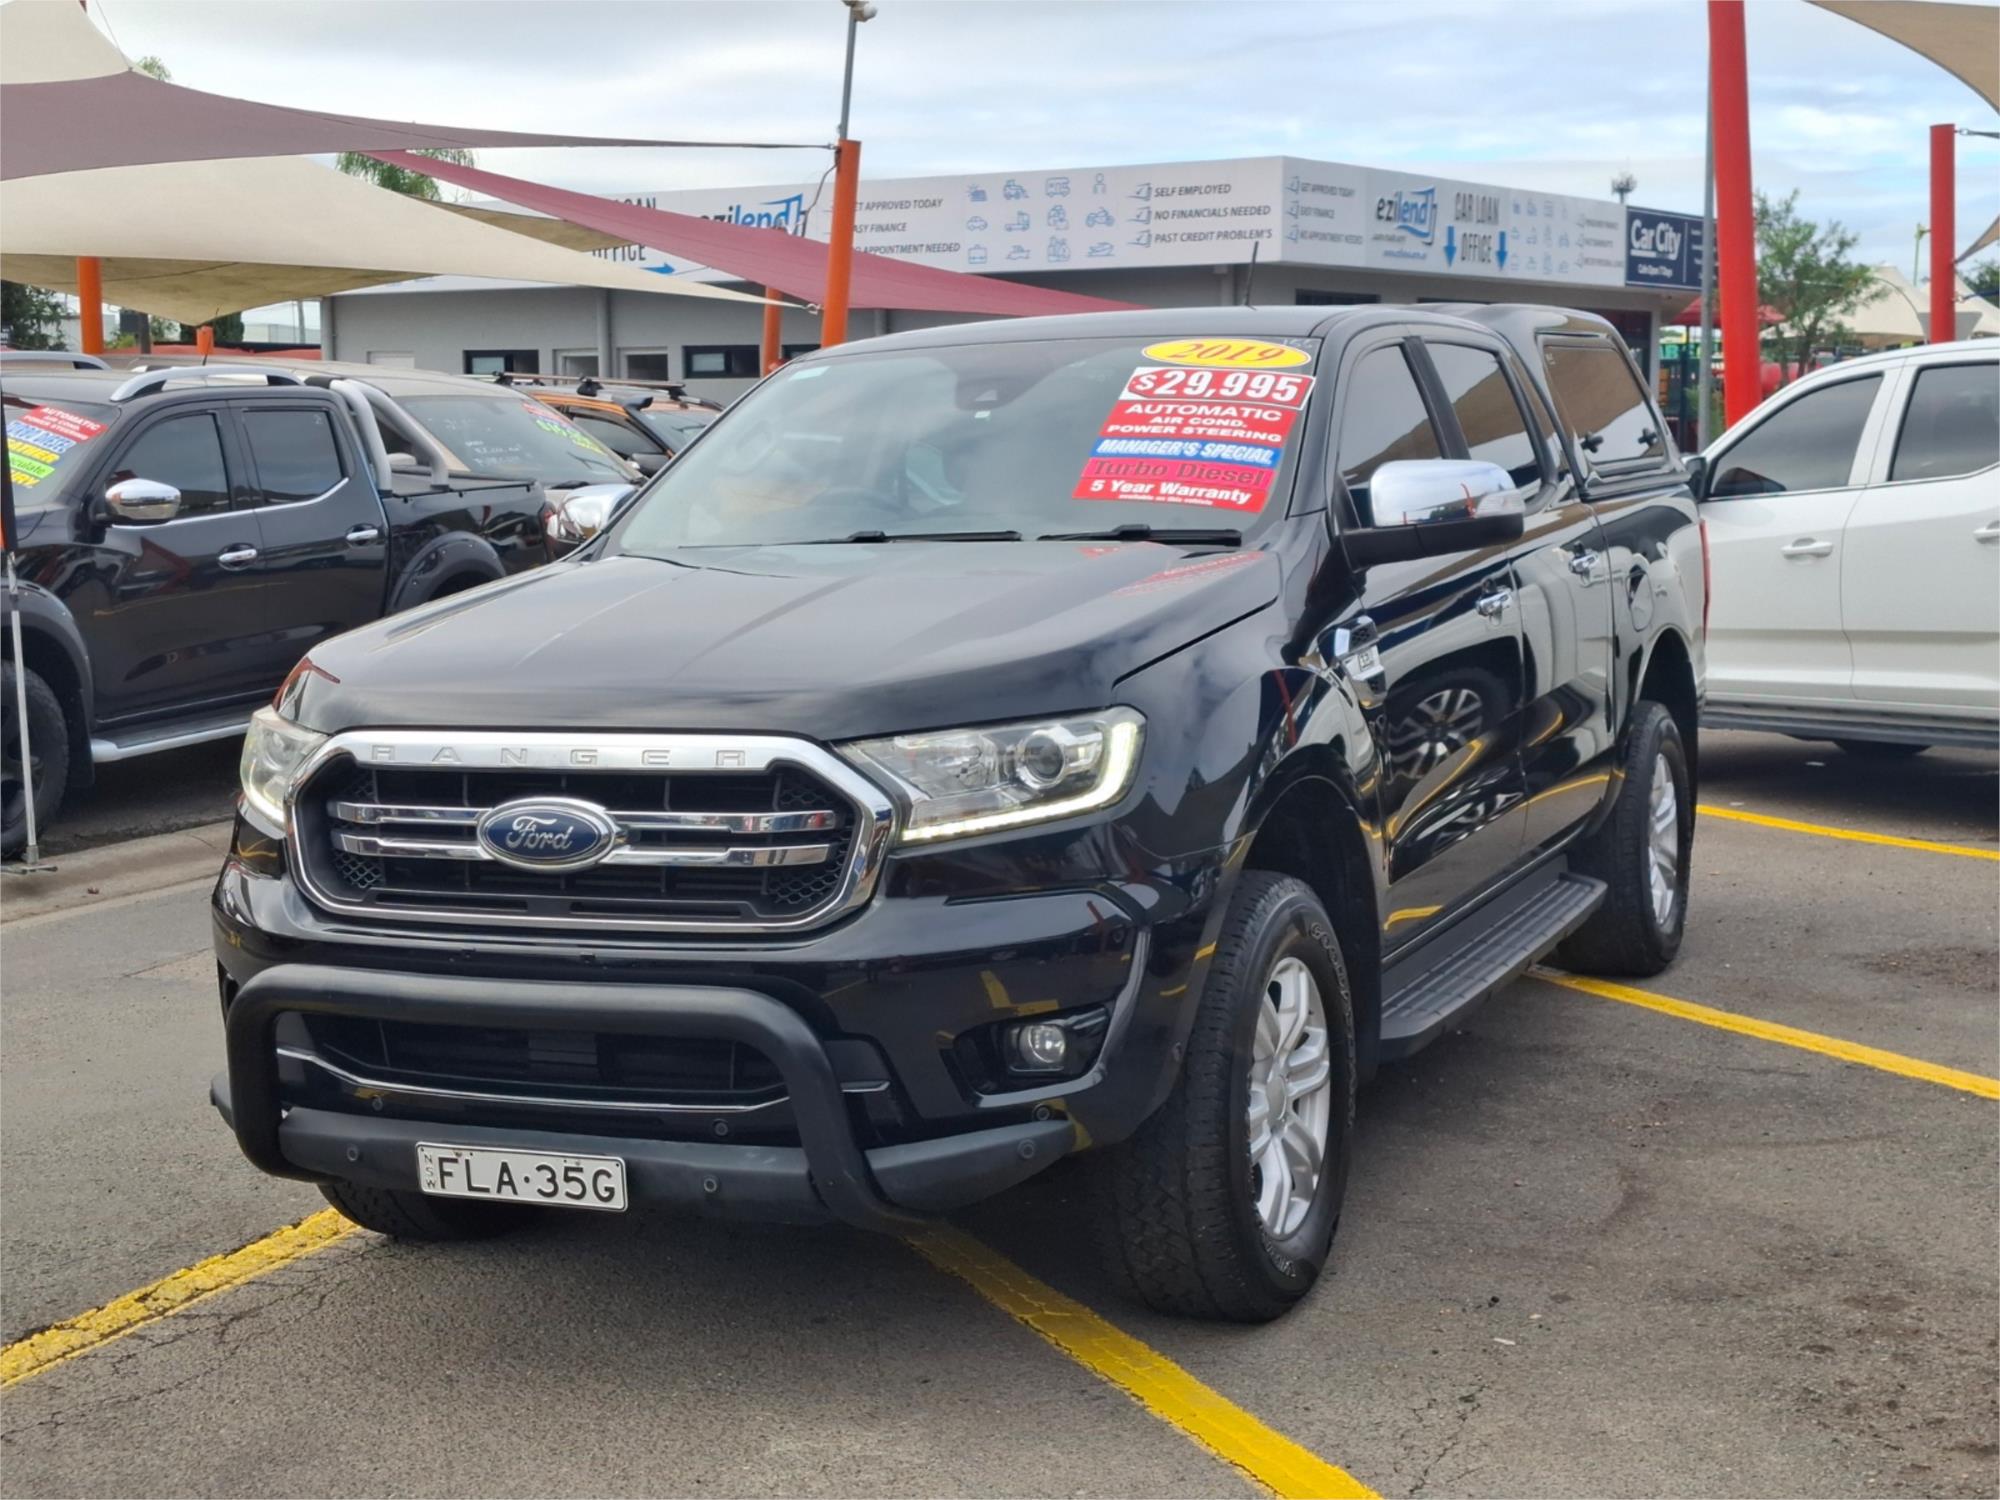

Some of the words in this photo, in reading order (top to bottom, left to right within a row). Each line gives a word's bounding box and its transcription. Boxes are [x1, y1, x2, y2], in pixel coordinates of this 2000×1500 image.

[1154, 187, 1176, 197] SELF
[1178, 184, 1232, 196] EMPLOYED
[864, 200, 911, 211] APPROVED
[913, 198, 943, 209] TODAY
[1154, 211, 1170, 221] NO
[1171, 207, 1229, 219] FINANCIALS
[1230, 205, 1272, 216] NEEDED
[1455, 191, 1474, 222] CAR
[1475, 194, 1500, 225] LOAN
[852, 224, 869, 234] ASY
[870, 222, 907, 233] FINANCE
[1154, 232, 1179, 243] PAST
[1180, 230, 1215, 242] CREDIT
[1216, 229, 1272, 241] PROBLEM'S
[926, 242, 961, 253] NEEDED
[1461, 232, 1492, 263] OFFICE
[1631, 219, 1655, 250] Car
[1656, 221, 1681, 260] City
[1167, 343, 1286, 362] 2019
[1135, 371, 1303, 402] $29,995
[1125, 404, 1283, 421] AUTOMATIC
[1150, 416, 1183, 425] AIR
[1188, 417, 1248, 428] COND.
[1107, 424, 1176, 435] POWER
[1181, 425, 1283, 443] STEERING
[1096, 438, 1198, 457] MANAGER'S
[1201, 442, 1275, 466] SPECIAL
[1094, 461, 1169, 477] Turbo
[1176, 463, 1266, 486] Diesel
[1090, 479, 1105, 492] 5
[1110, 480, 1155, 494] Year
[1159, 482, 1252, 504] Warranty
[370, 744, 747, 768] RANGER
[505, 815, 573, 851] Ford
